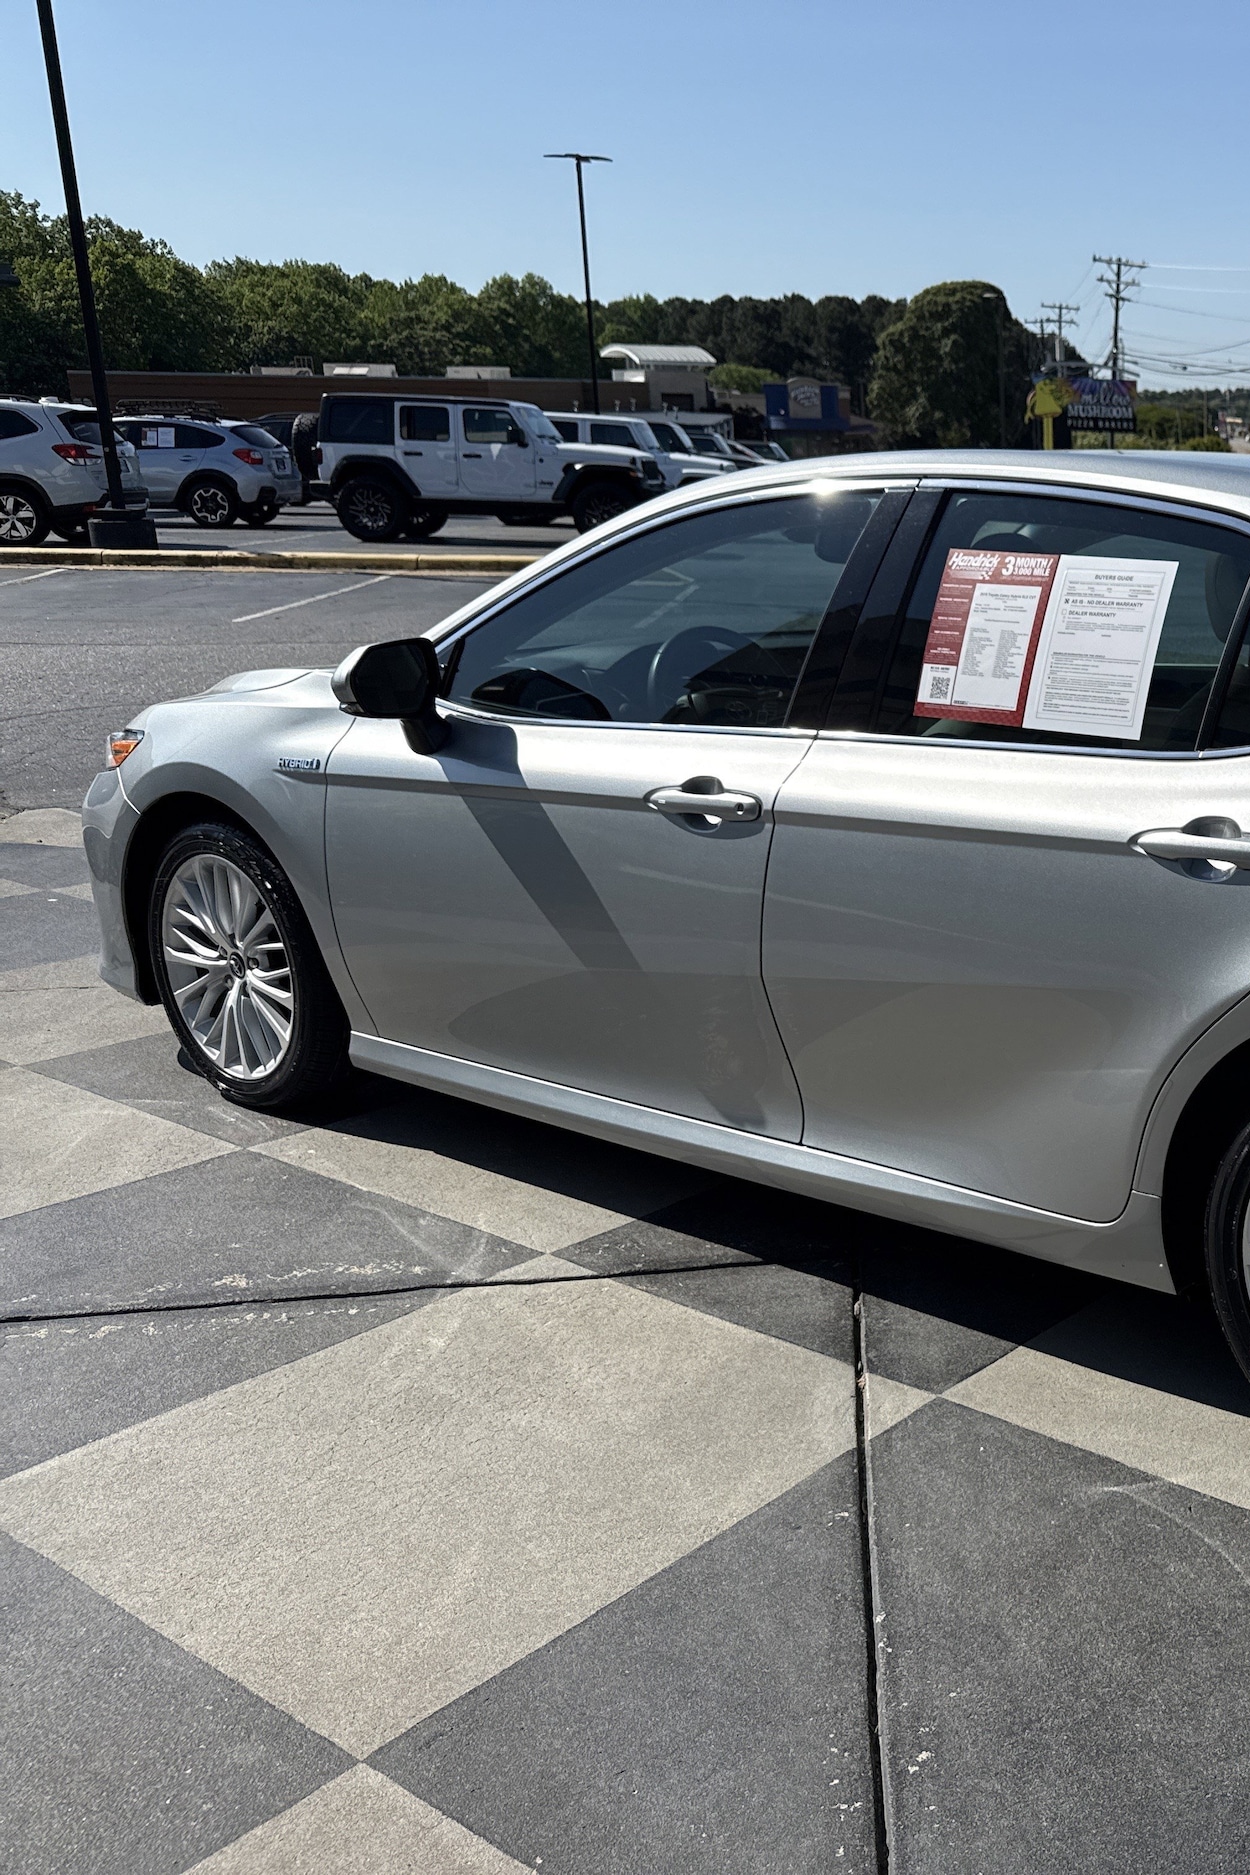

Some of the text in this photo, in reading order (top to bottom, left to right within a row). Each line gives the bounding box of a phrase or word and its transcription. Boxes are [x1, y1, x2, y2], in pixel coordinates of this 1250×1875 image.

[1067, 404, 1133, 419] MUSHROOM
[949, 552, 1001, 570] Hendrick
[1001, 556, 1015, 576] 3
[1015, 557, 1054, 569] MONTH/
[1033, 568, 1051, 577] MILE
